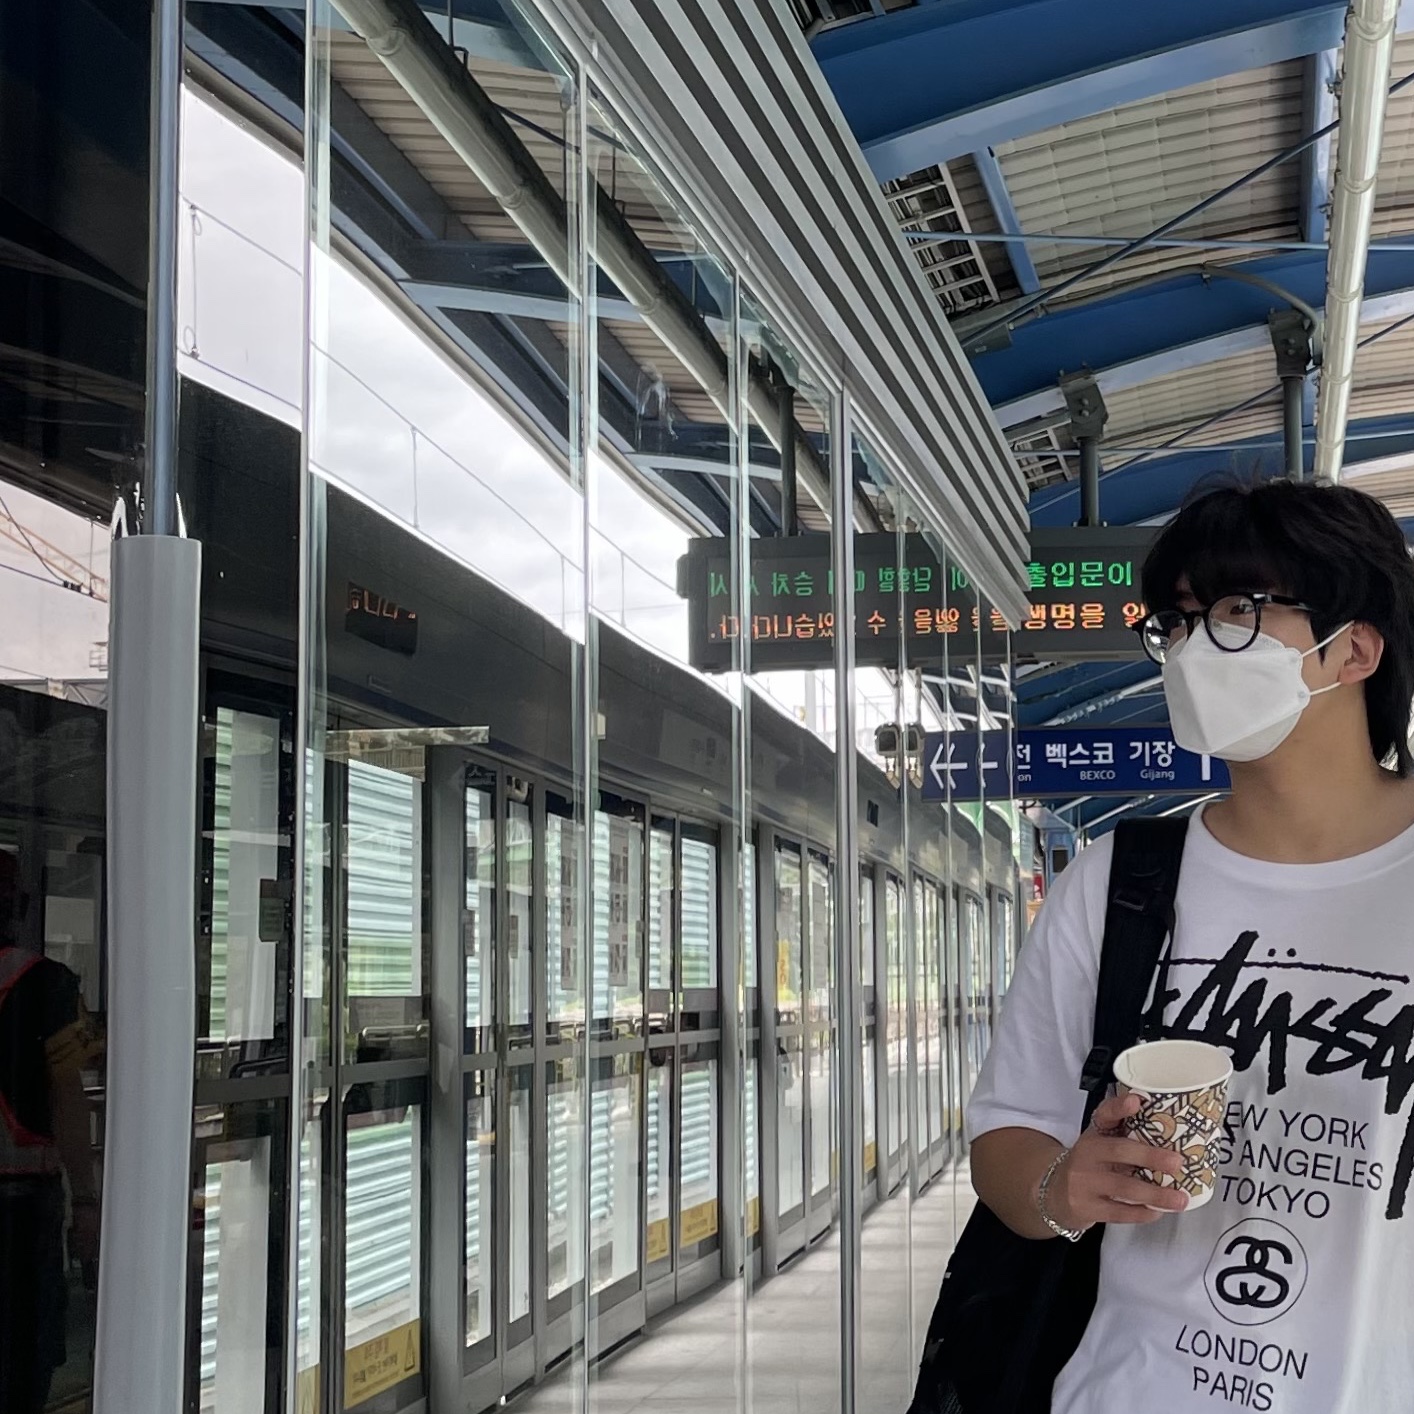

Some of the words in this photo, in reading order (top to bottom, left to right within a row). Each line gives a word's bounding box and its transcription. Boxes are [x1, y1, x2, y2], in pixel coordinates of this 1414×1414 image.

[1045, 742, 1114, 768] 벡스코
[1130, 741, 1176, 767] 기장
[1080, 770, 1116, 780] BEXCO
[1140, 769, 1175, 781] Gijang
[1223, 1101, 1268, 1132] EW
[1280, 1109, 1369, 1150] YORK
[1239, 1140, 1384, 1191] ANGELES
[1221, 1174, 1330, 1219] TOKYO
[1175, 1324, 1308, 1379] LONDON
[1193, 1367, 1274, 1412] PARIS
